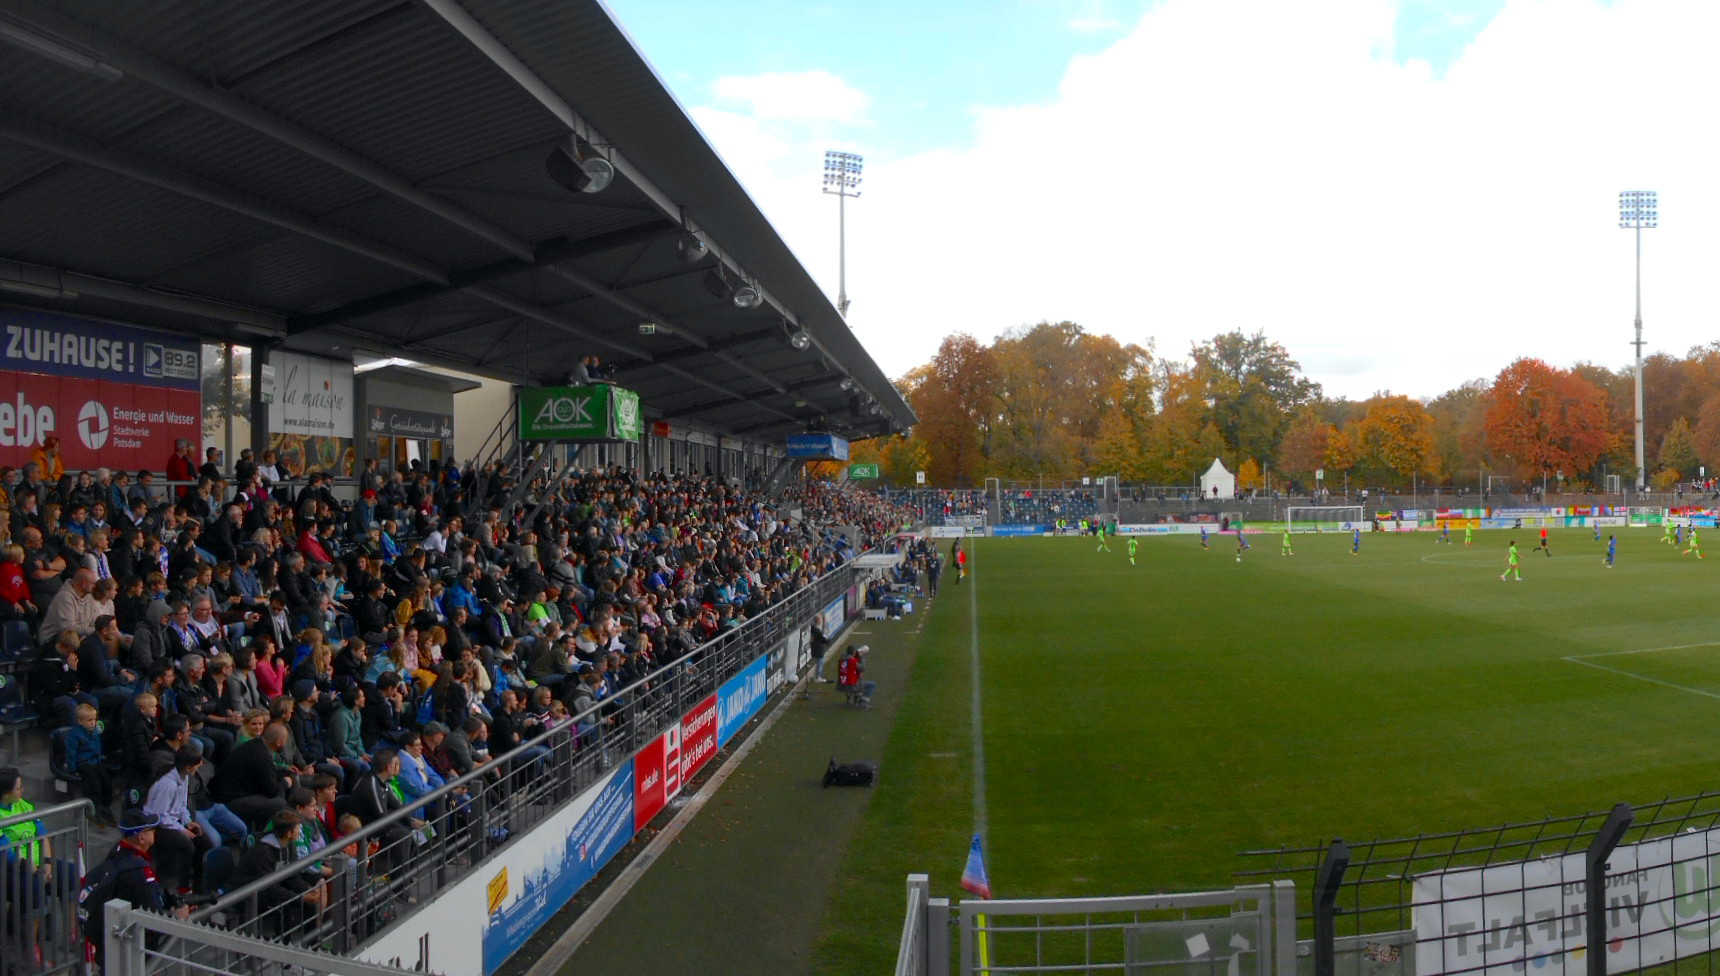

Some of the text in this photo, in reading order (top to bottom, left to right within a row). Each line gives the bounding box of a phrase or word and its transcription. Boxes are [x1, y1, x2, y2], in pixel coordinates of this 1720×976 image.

[6, 325, 123, 372] ZUHAUSE
[164, 351, 196, 368] 89.2
[164, 368, 196, 378] POTSDAM
[114, 407, 195, 426] Energie und Wasser
[534, 397, 592, 423] AOK
[113, 425, 150, 437] Stadtwerke
[113, 438, 142, 449] Potsdam
[727, 688, 744, 719] JAKO
[751, 667, 766, 702] JAKO
[681, 704, 717, 743] Versicherungen
[681, 734, 714, 780] gibt's bei uns.
[641, 767, 659, 794] mbs.de
